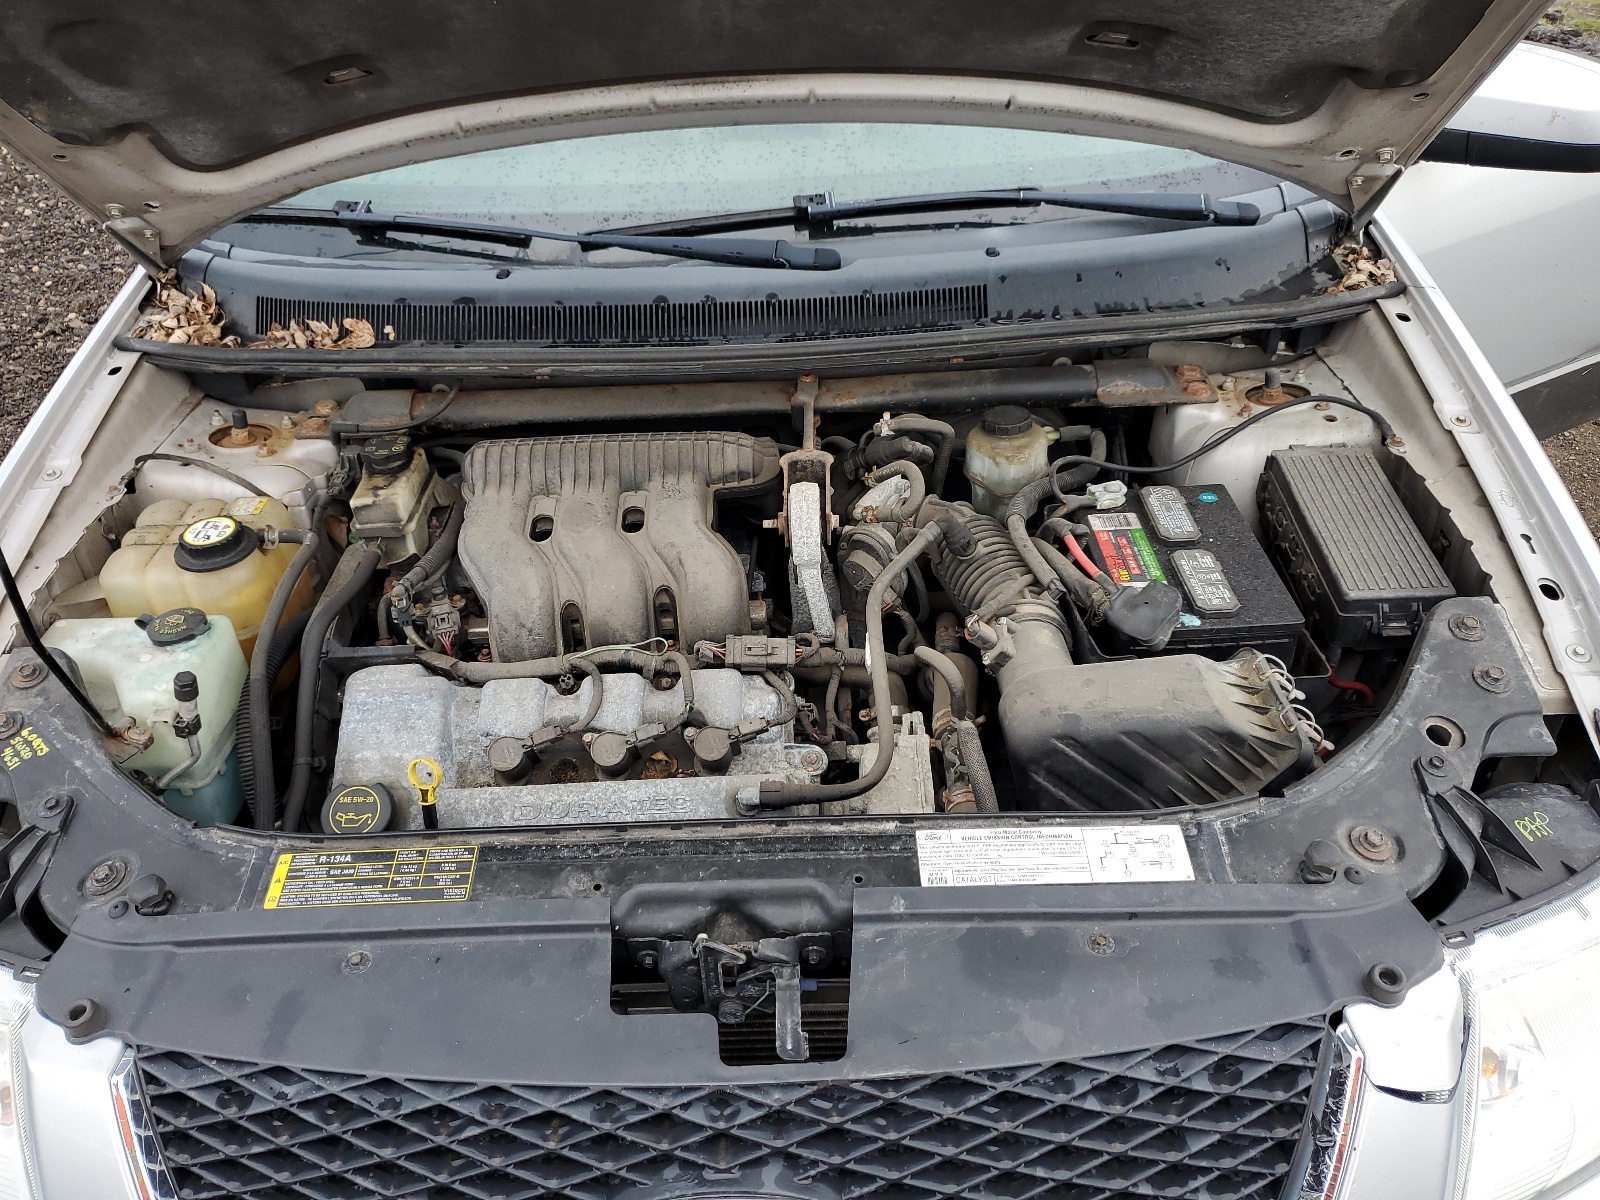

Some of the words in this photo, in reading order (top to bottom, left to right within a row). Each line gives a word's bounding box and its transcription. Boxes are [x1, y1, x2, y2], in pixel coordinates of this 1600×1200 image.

[0, 746, 22, 771] 4651
[9, 736, 33, 760] 5W20
[513, 796, 692, 821] DURATEC
[319, 854, 352, 865] R-134A
[955, 874, 993, 885] CATALYST
